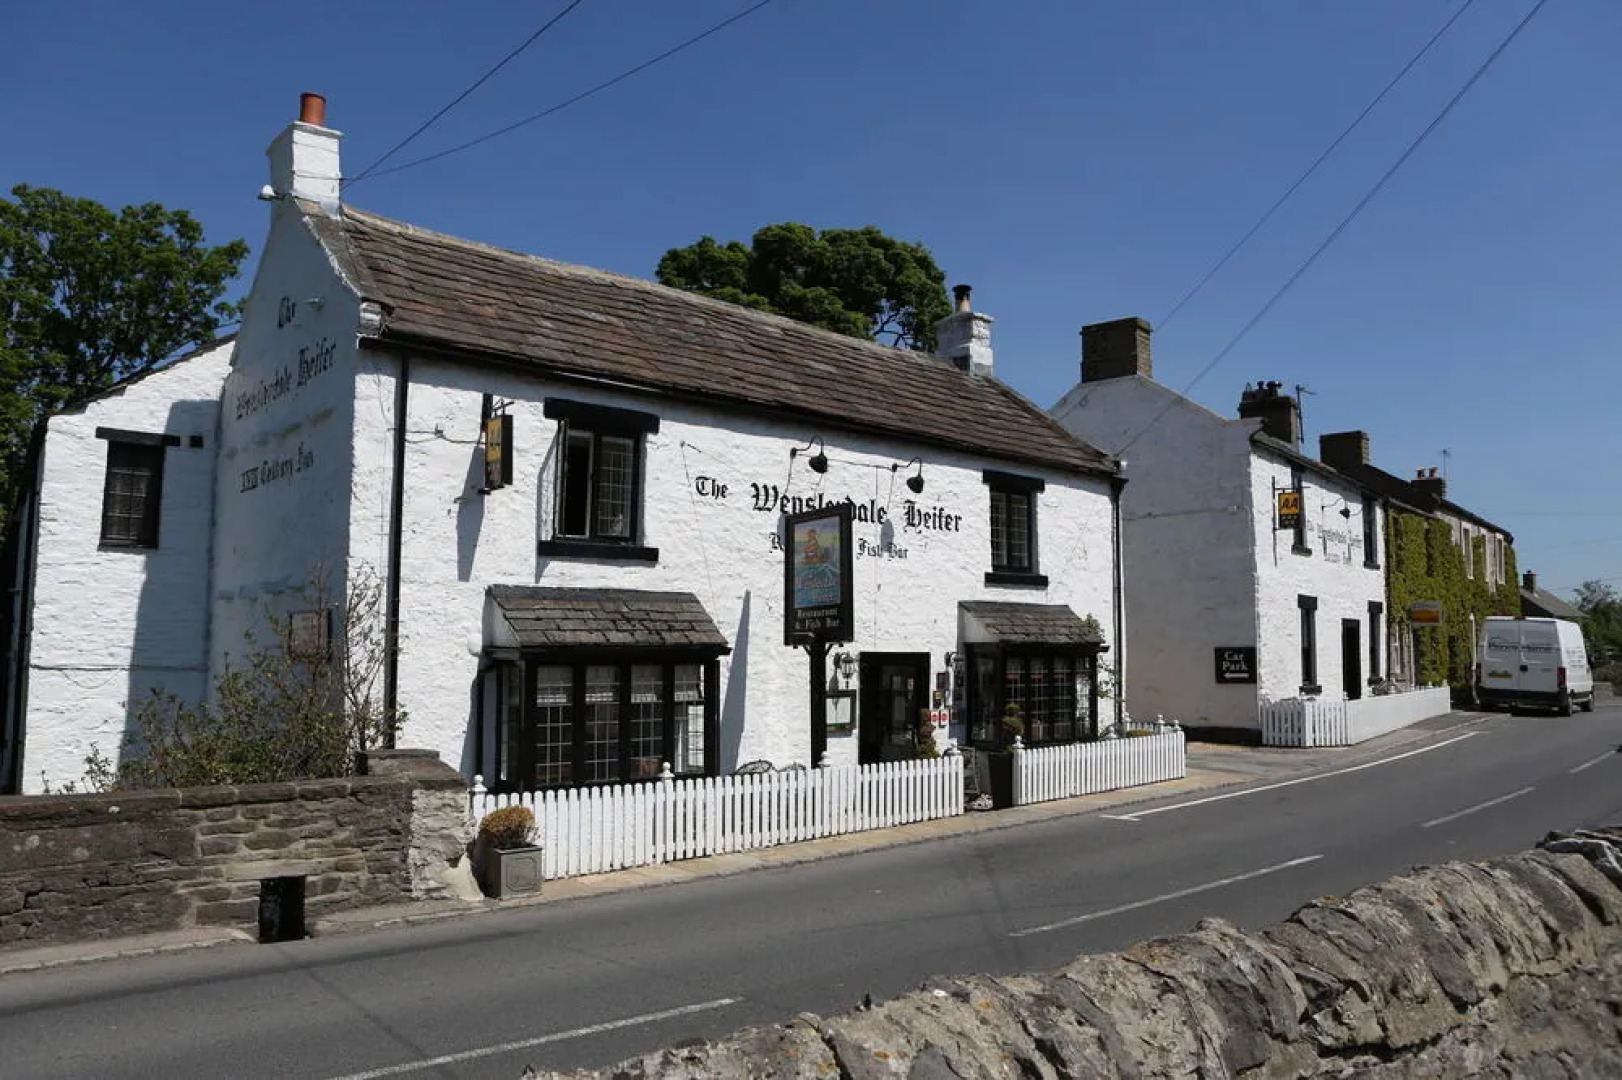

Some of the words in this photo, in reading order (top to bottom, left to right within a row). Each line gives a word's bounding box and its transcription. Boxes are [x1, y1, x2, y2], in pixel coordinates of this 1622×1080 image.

[695, 476, 729, 500] The
[750, 482, 888, 525] Wensldale
[903, 500, 962, 534] Heifer
[856, 537, 883, 560] Fish
[886, 542, 909, 561] Bar
[1224, 651, 1245, 661] Car
[1222, 660, 1249, 672] Park
